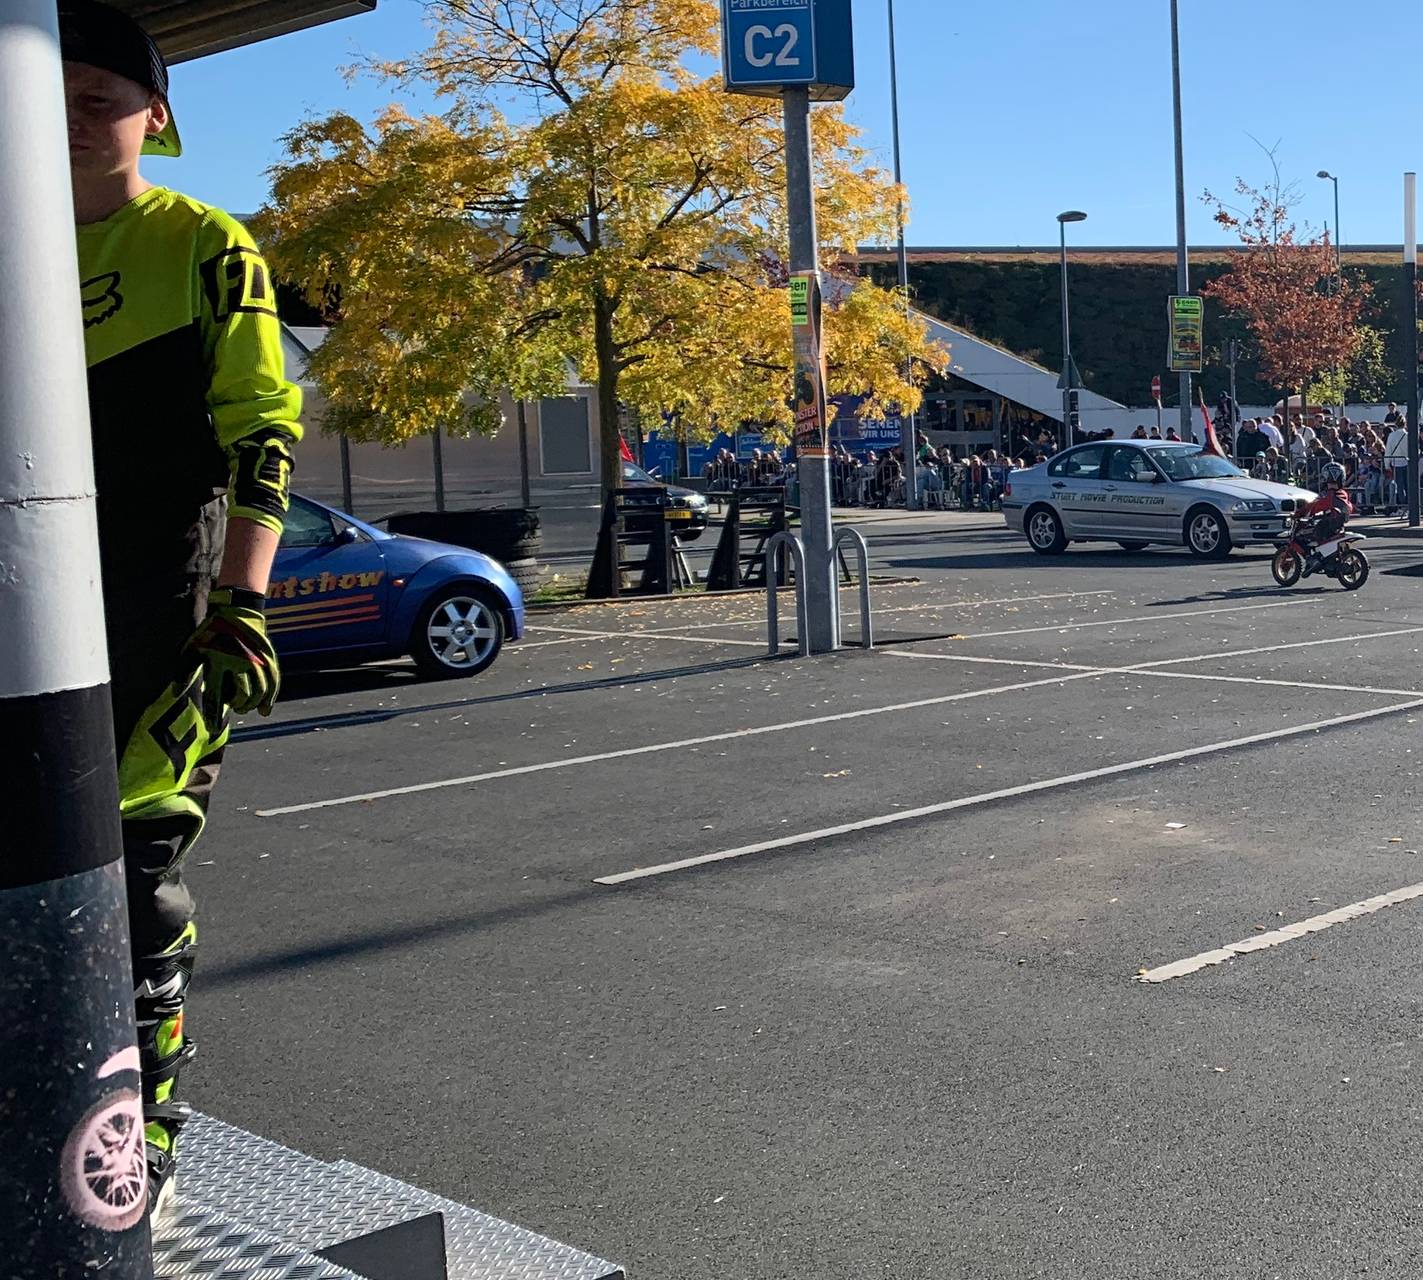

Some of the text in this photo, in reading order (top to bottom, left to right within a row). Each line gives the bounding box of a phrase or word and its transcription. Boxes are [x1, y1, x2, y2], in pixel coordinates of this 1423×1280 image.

[744, 23, 800, 67] C2
[859, 430, 900, 439] WIR UNS
[1111, 495, 1166, 505] PRODUCTION
